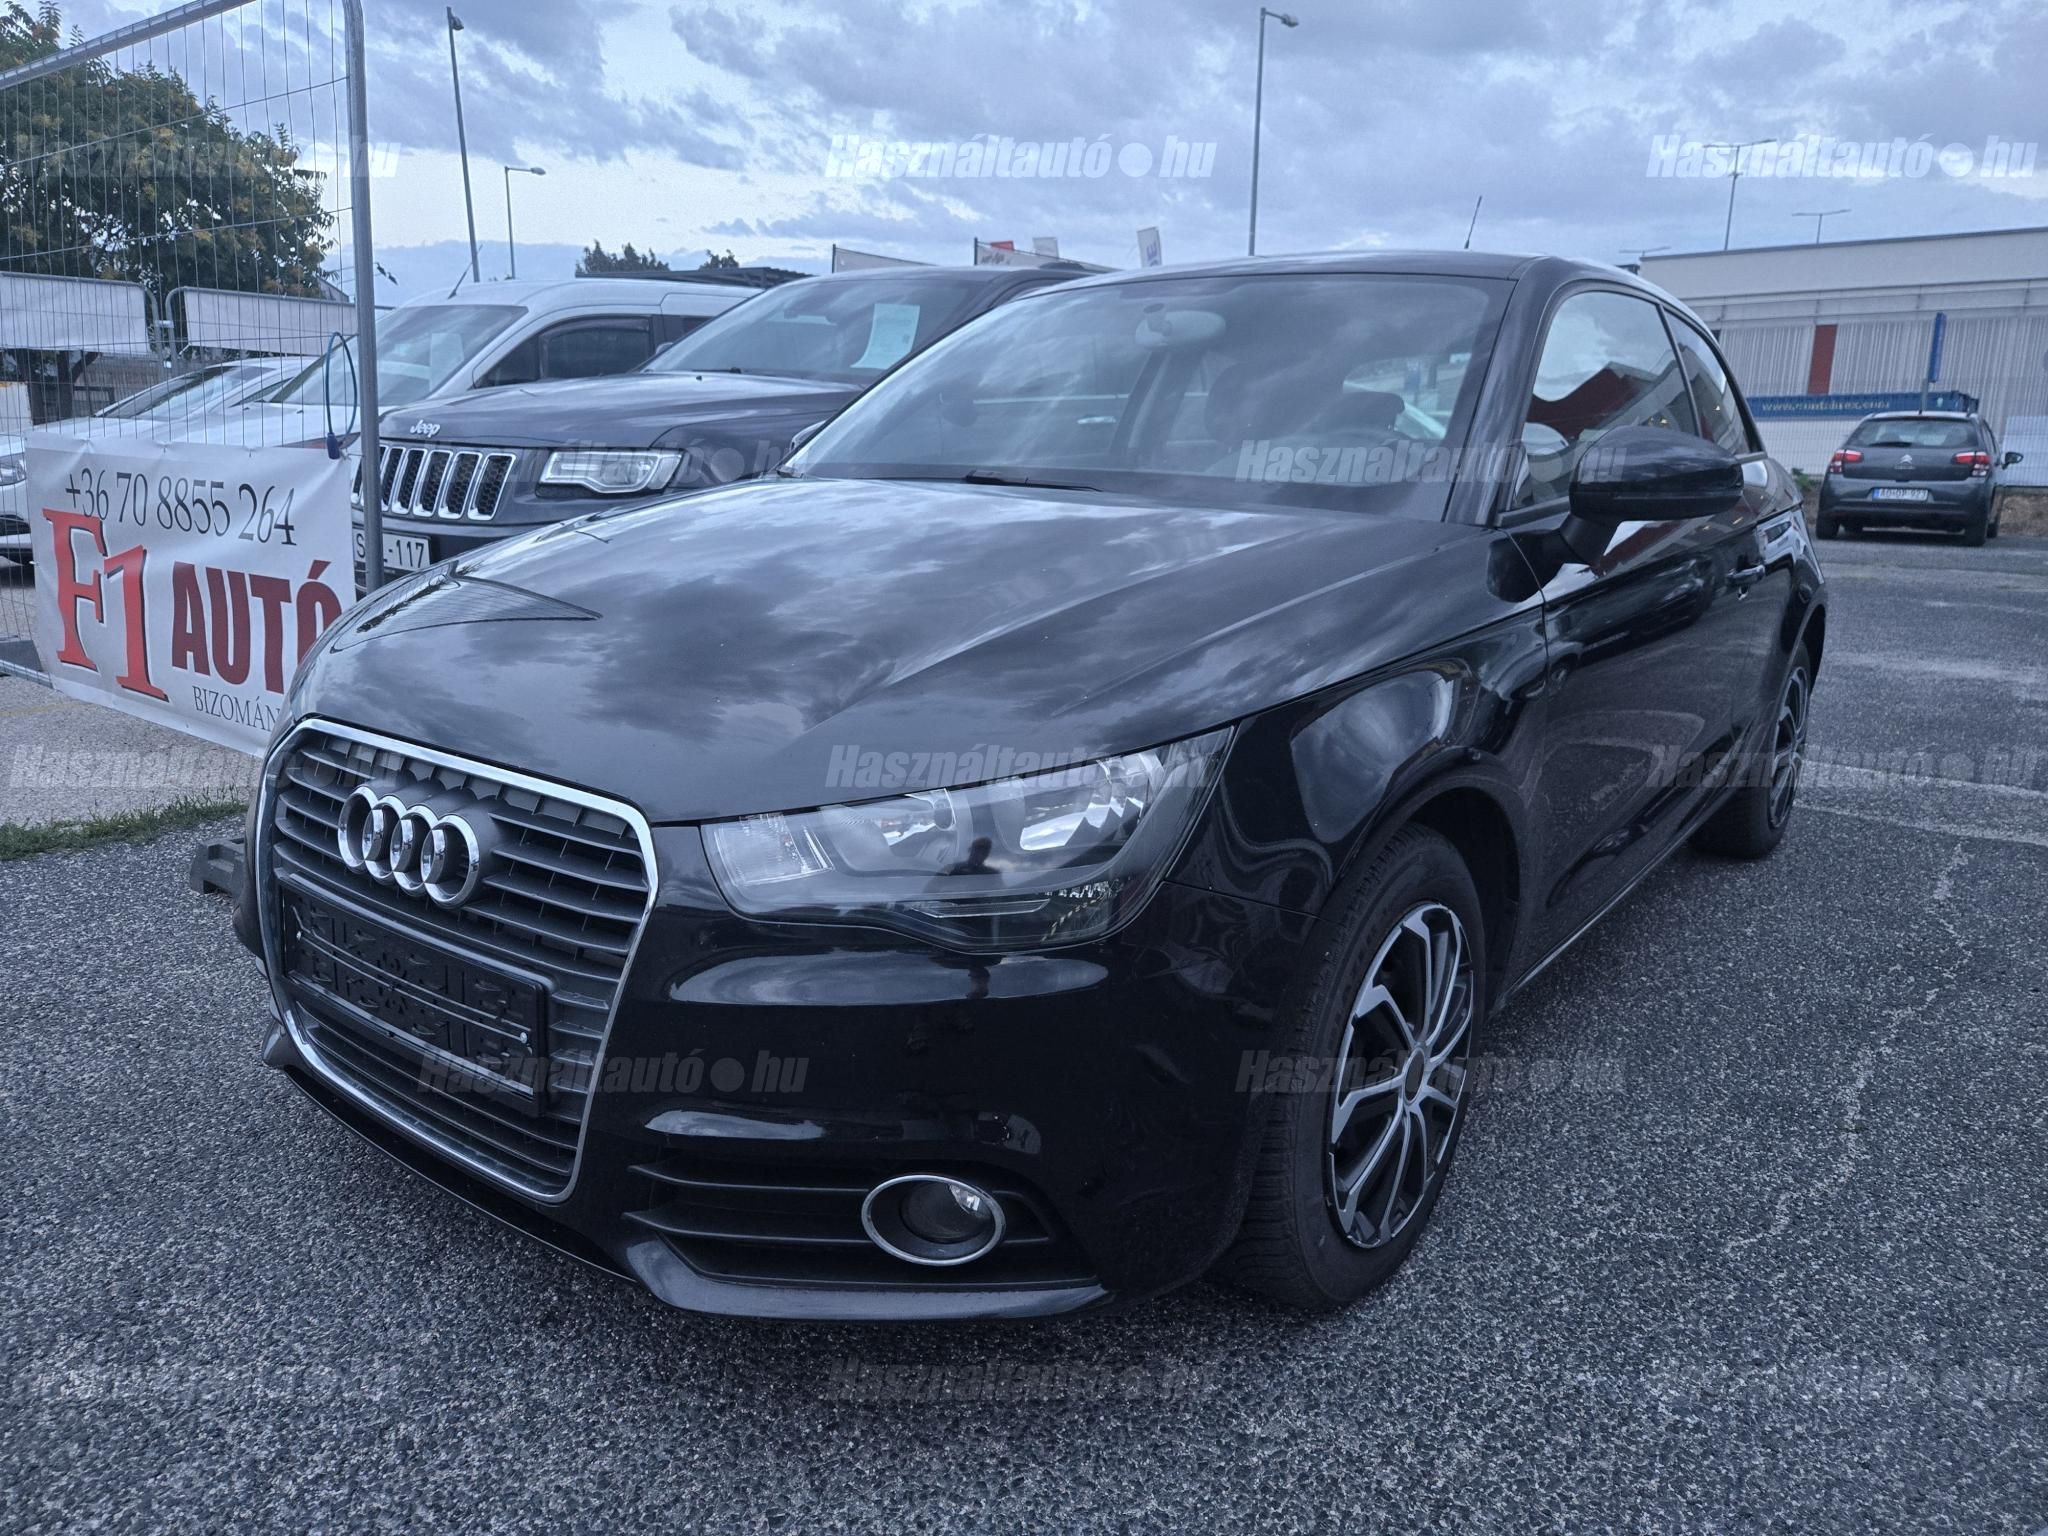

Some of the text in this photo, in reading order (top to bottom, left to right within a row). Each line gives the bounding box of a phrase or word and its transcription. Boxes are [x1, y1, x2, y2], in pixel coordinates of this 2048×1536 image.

[409, 420, 440, 438] Jeep
[65, 467, 297, 546] +36 70 8855 264
[42, 508, 343, 702] F1 AUTÓ
